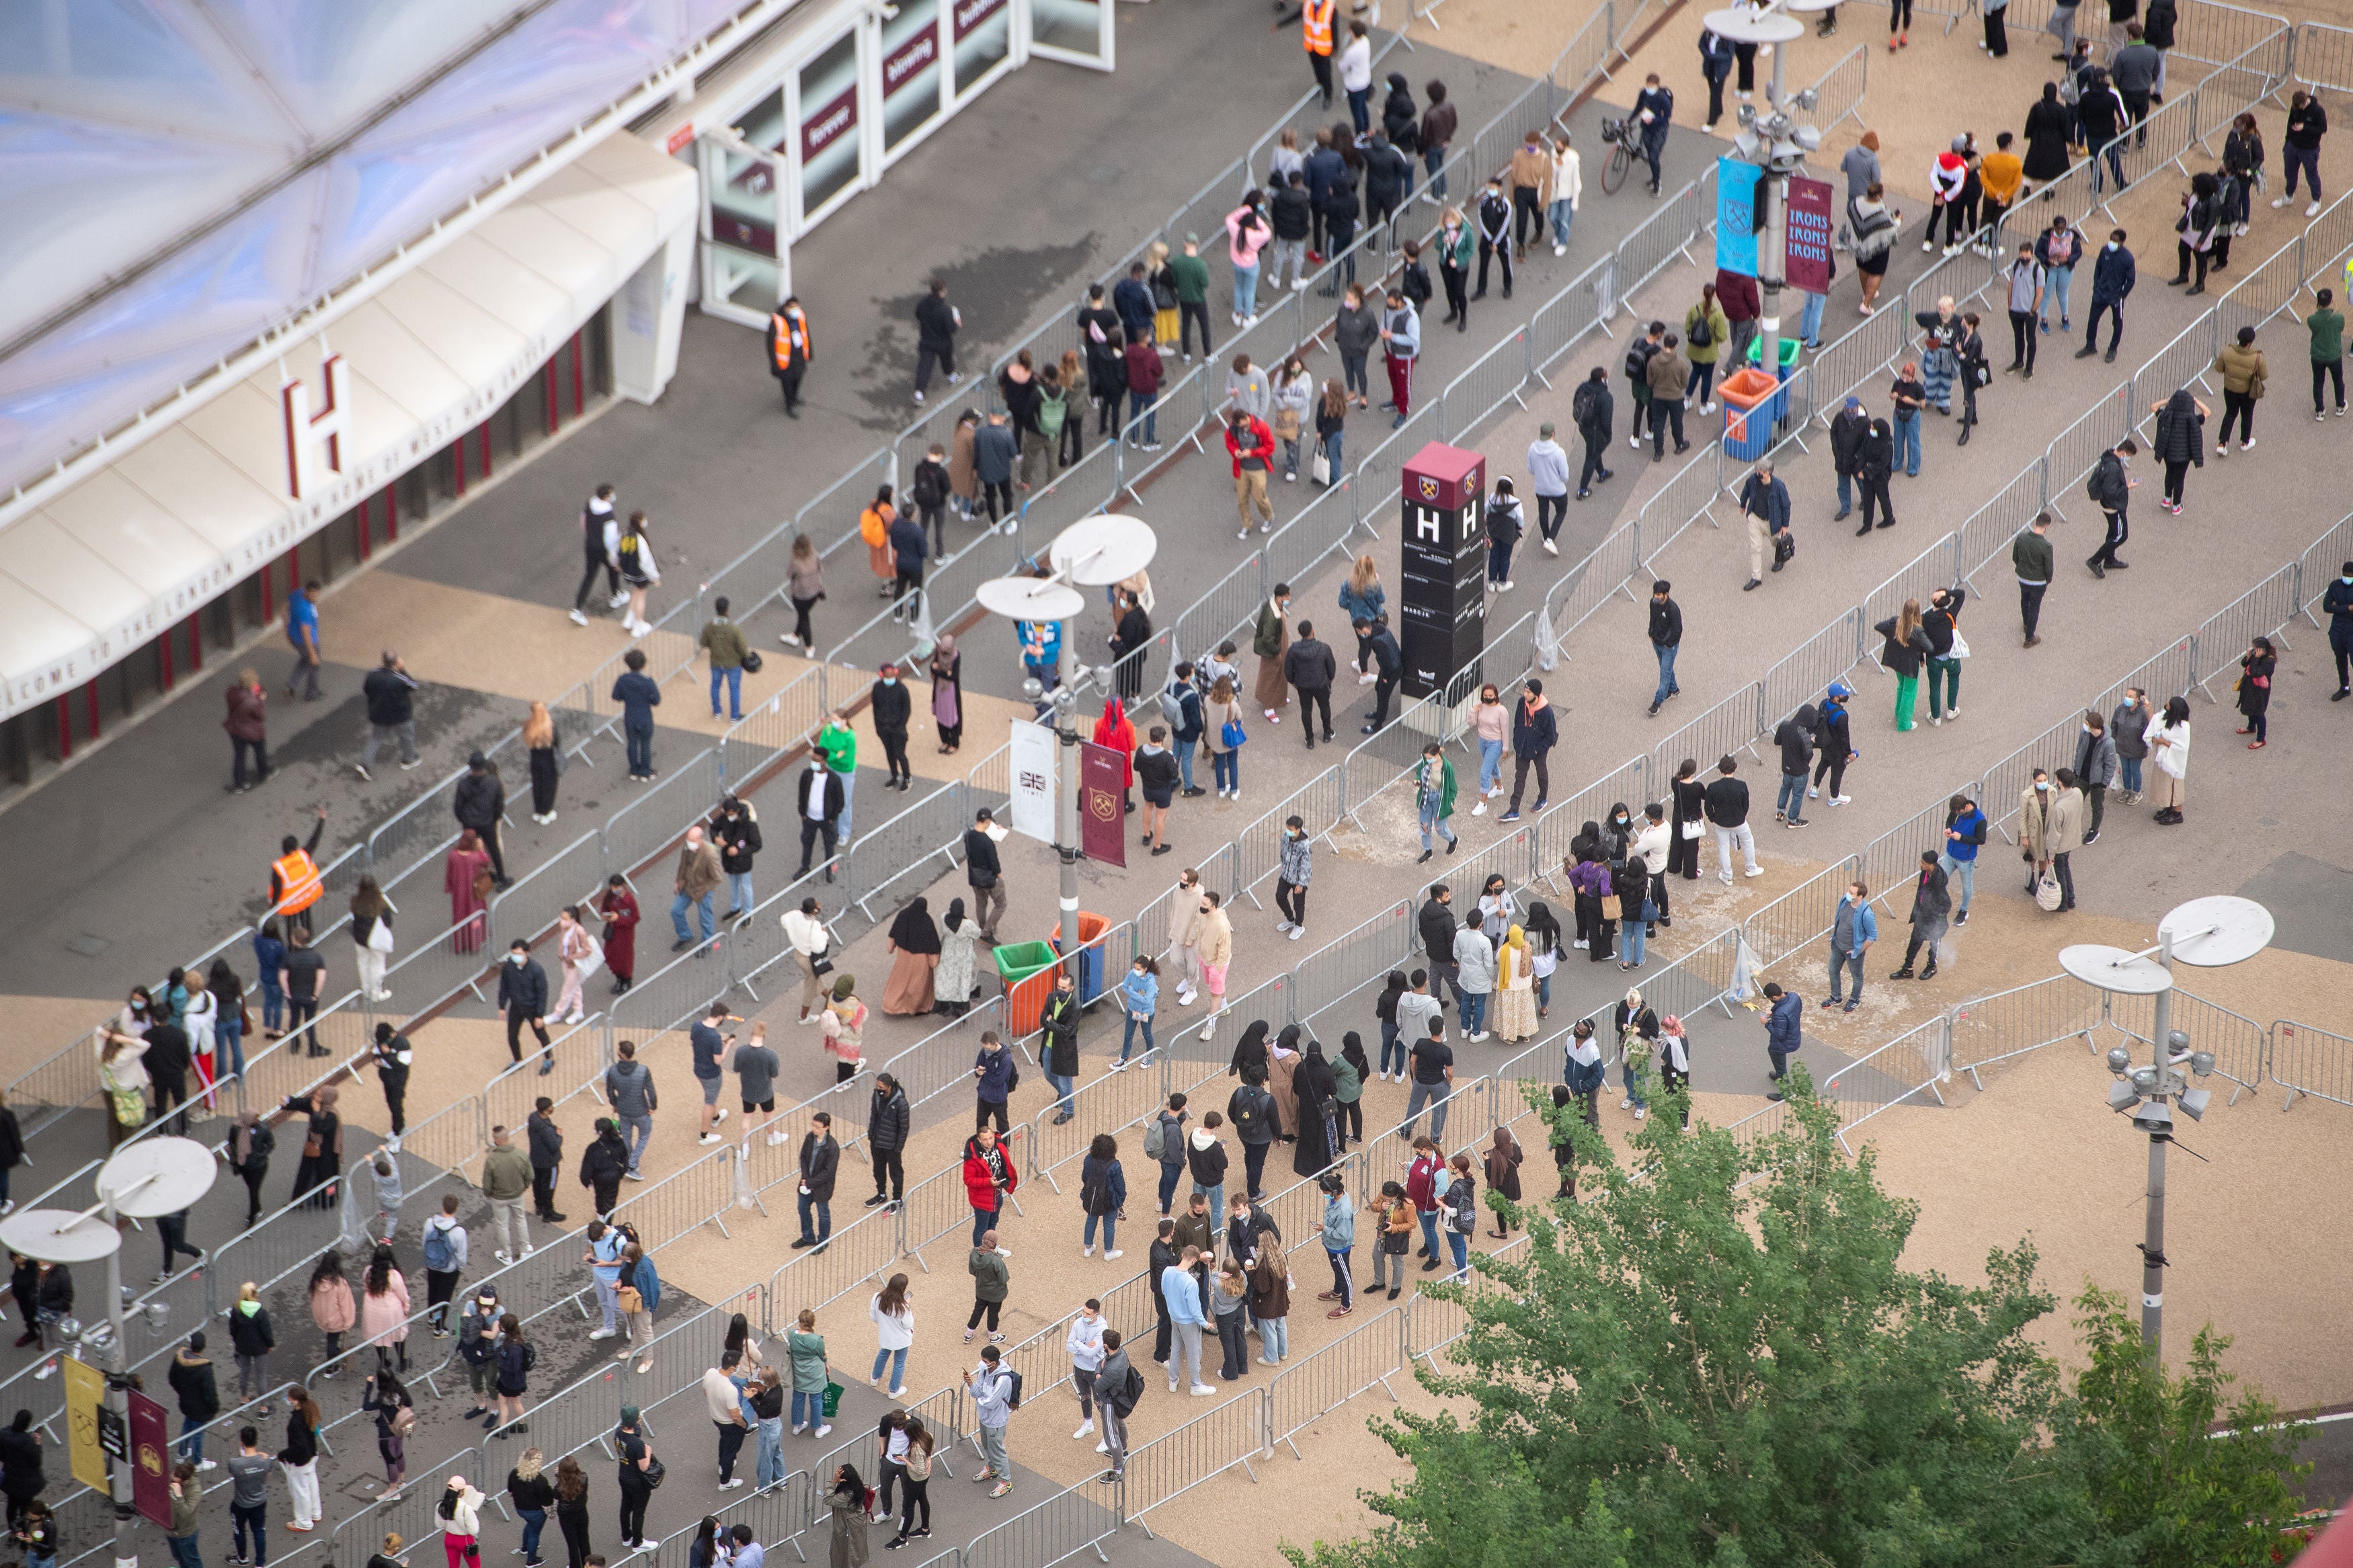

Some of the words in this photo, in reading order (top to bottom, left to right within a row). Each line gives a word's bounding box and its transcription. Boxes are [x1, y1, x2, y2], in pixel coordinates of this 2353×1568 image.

[808, 105, 850, 147] forever
[887, 38, 933, 82] blowing
[1789, 226, 1827, 245] IRONS
[1790, 209, 1828, 229] IRONS
[1788, 243, 1826, 262] IRONS
[281, 350, 352, 500] H
[1417, 507, 1439, 544] H
[1463, 499, 1476, 540] H
[89, 641, 111, 666] TO
[122, 612, 155, 643] THE
[164, 559, 235, 617] LONDON
[244, 503, 321, 565] STADIUM
[330, 468, 374, 507] HOME
[410, 415, 452, 454] WEST
